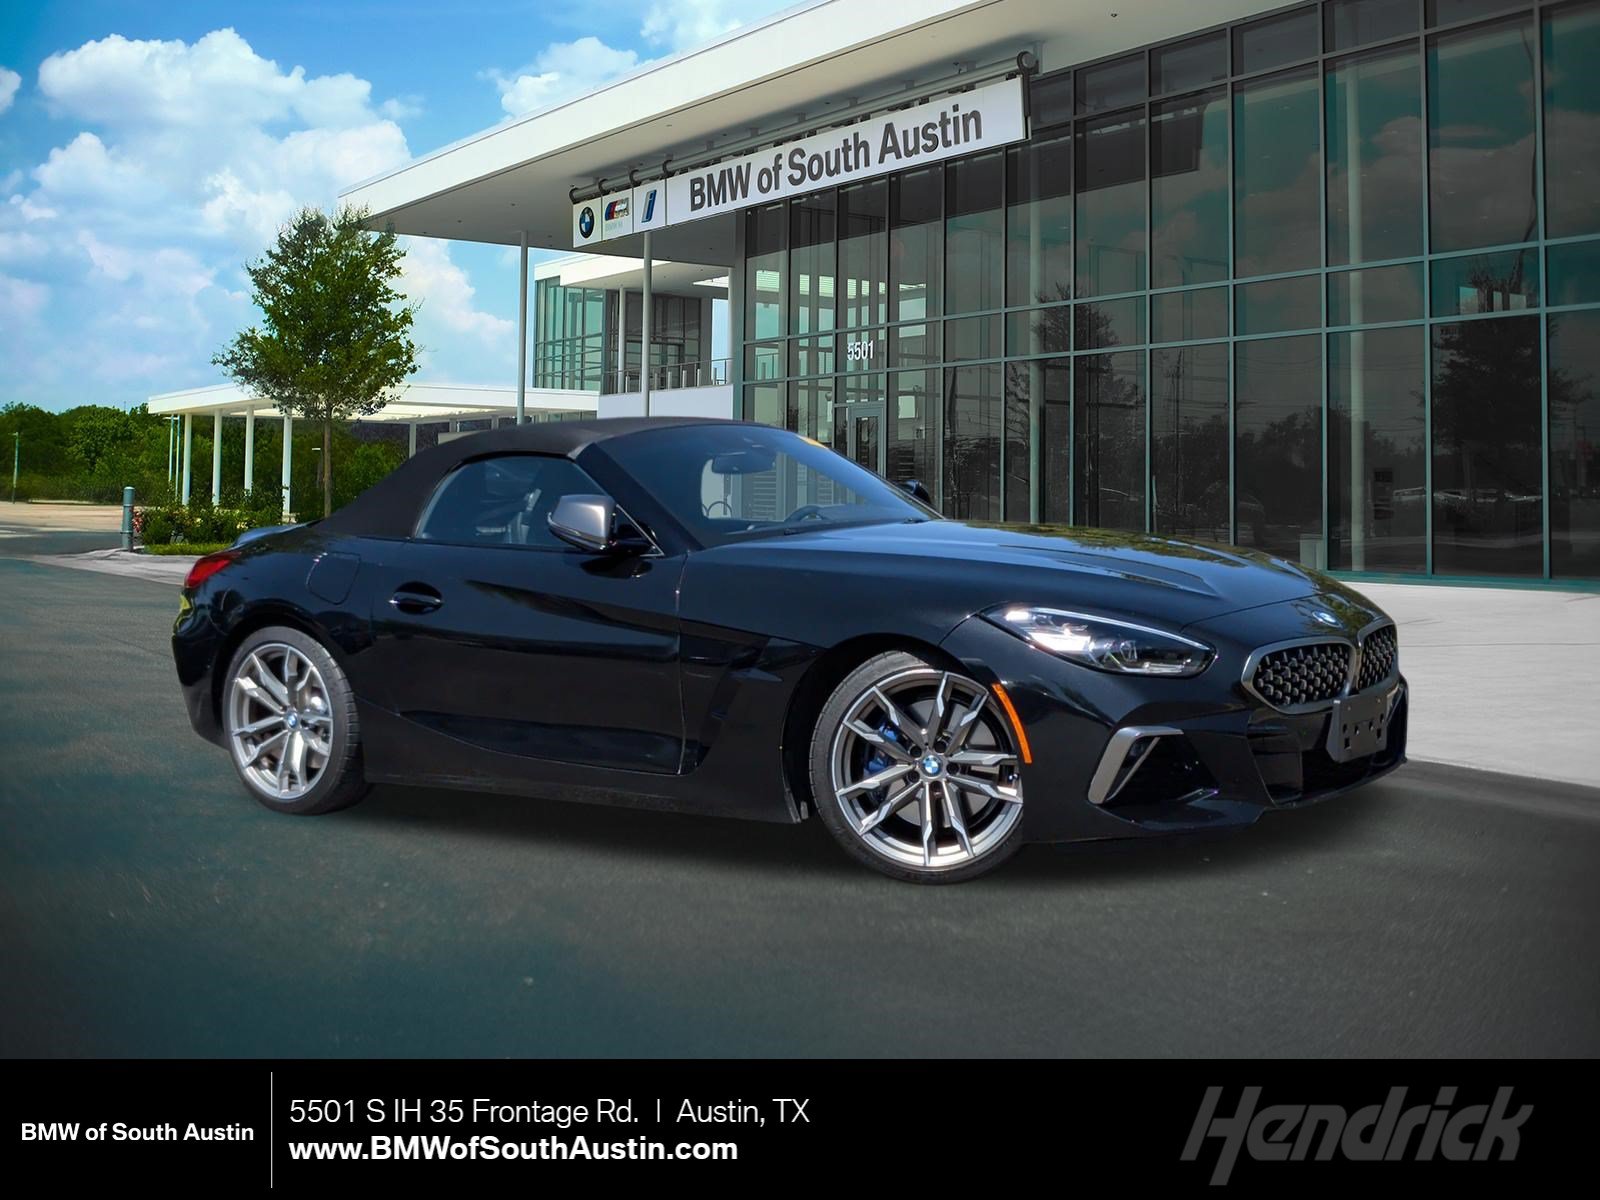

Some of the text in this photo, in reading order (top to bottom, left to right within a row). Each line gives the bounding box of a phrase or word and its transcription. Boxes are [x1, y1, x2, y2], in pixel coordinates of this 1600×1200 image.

[690, 162, 751, 212] BMW
[757, 153, 783, 194] of
[788, 132, 870, 187] South
[878, 104, 982, 165] Austin
[847, 340, 874, 361] 5501
